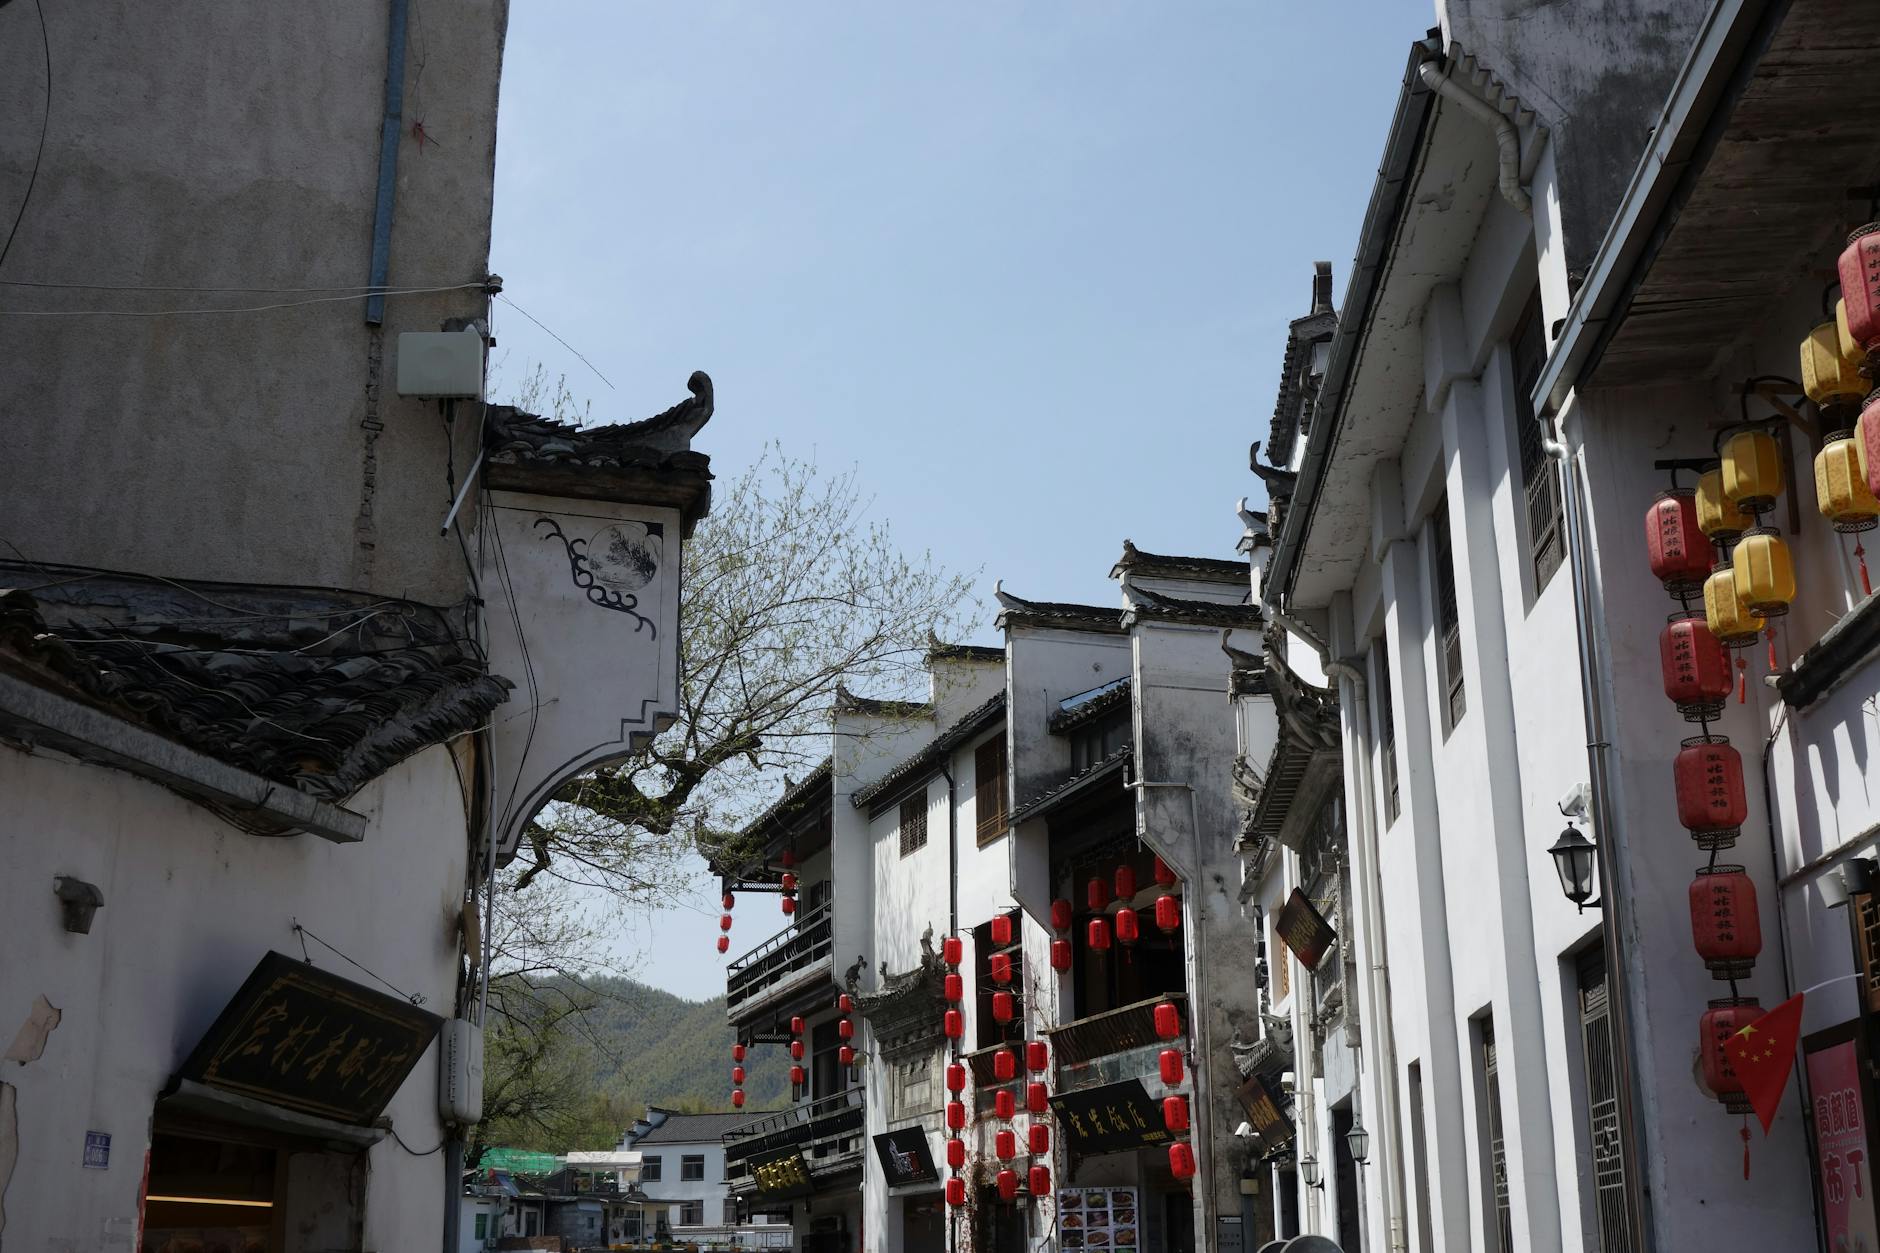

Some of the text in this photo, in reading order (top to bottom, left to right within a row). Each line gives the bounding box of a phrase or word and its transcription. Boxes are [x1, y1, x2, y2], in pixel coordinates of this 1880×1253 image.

[1817, 1089, 1860, 1136] 高颜值
[1823, 1148, 1863, 1203] 布丁
